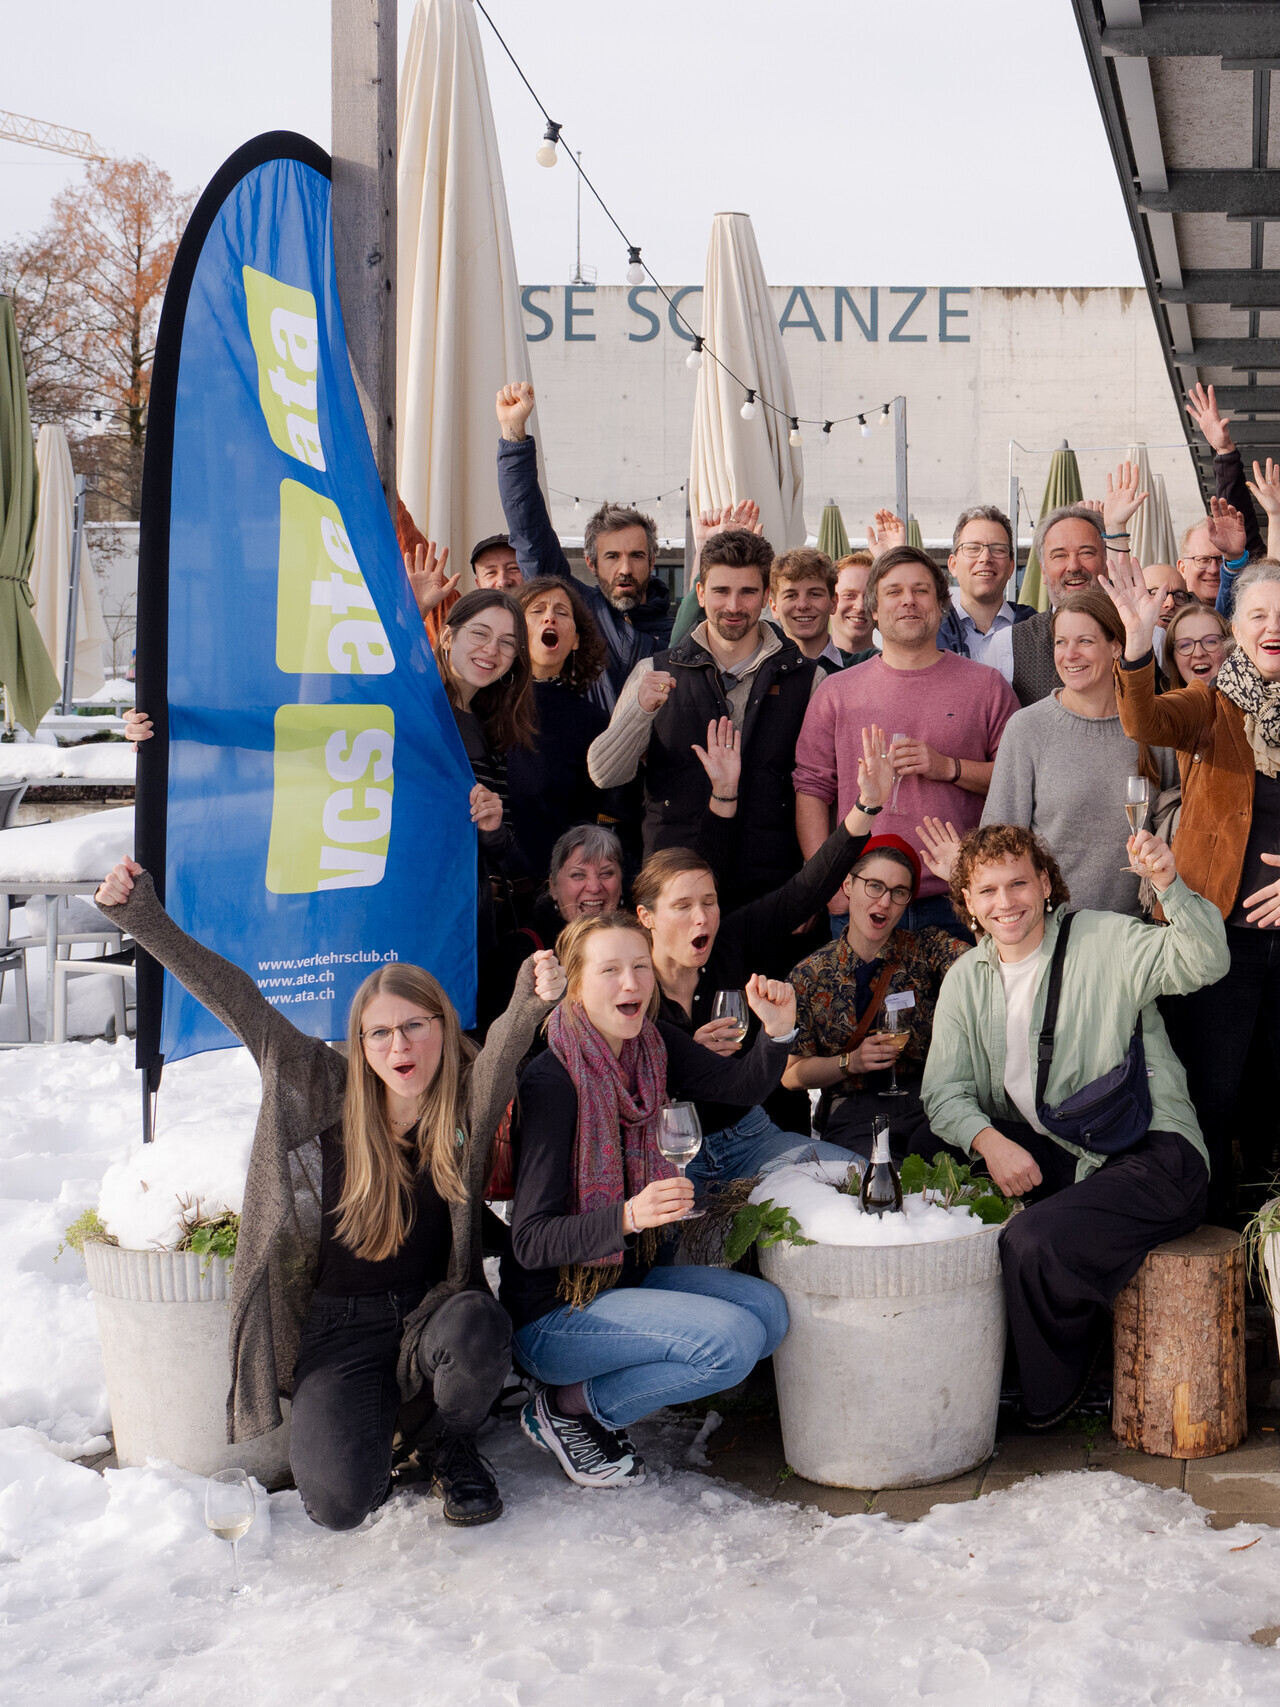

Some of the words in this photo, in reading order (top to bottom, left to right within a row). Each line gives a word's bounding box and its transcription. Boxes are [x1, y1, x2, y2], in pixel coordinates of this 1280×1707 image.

[521, 286, 596, 342] SE
[627, 286, 971, 342] SCANZE
[270, 307, 327, 472] ata
[311, 515, 396, 675] ate
[317, 728, 395, 891] vcs
[257, 970, 335, 989] www.ate.ch
[258, 949, 399, 970] www.verkehrsclub.ch
